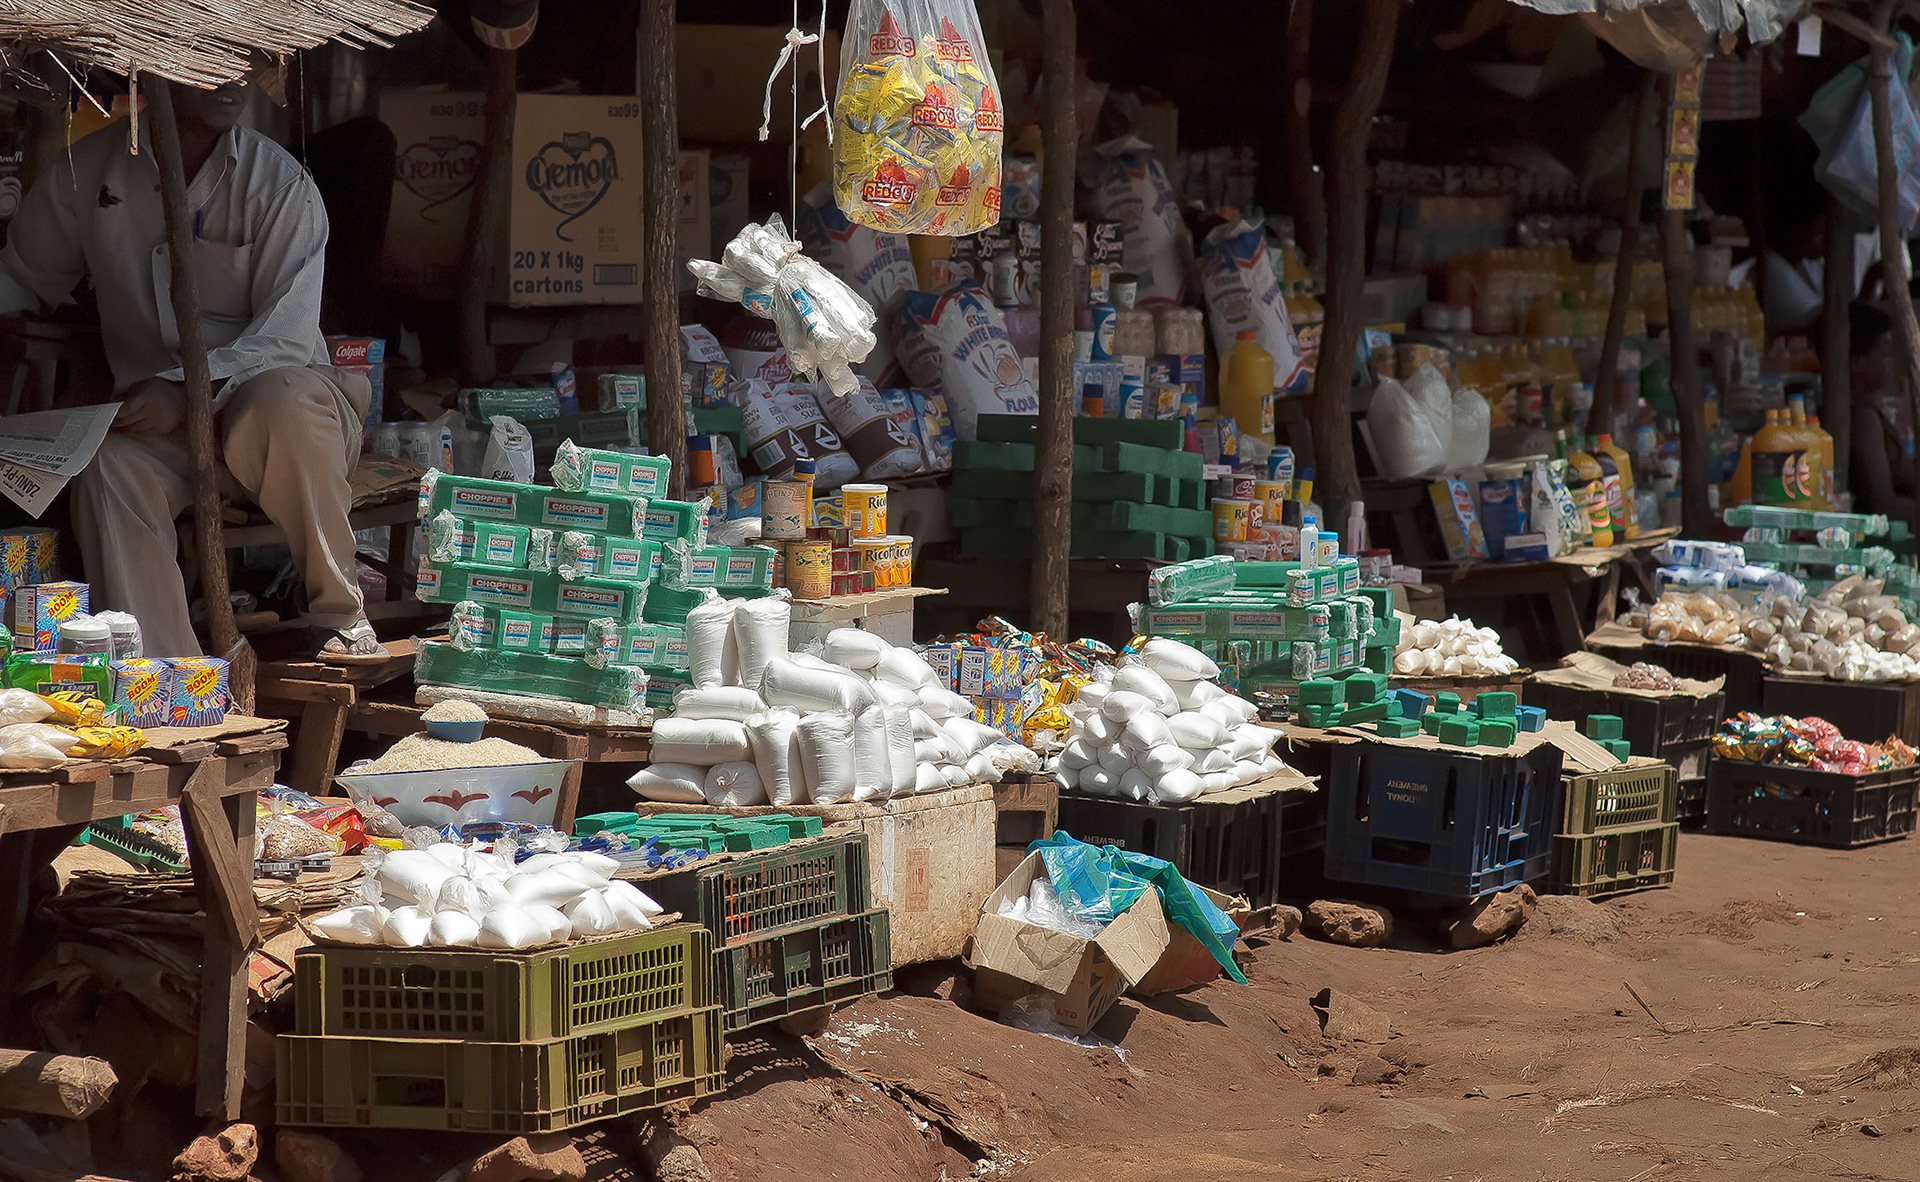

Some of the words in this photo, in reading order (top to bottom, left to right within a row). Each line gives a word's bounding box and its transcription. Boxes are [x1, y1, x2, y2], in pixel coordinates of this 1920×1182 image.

[526, 152, 618, 192] Cremora
[513, 251, 536, 270] 20
[540, 251, 551, 270] X
[557, 250, 585, 273] 1kg
[855, 249, 893, 286] WHITE
[892, 246, 912, 262] BRE
[513, 277, 585, 294] cartons
[952, 326, 989, 362] WHITE
[988, 325, 1012, 342] BRE
[336, 345, 367, 360] Colgate
[792, 401, 816, 412] BRO
[1004, 396, 1038, 414] FLOUR
[742, 407, 760, 421] OWN
[801, 410, 821, 420] SUG
[460, 492, 508, 504] CHOPPIES
[768, 488, 792, 499] HEINZ
[551, 503, 600, 515] CHOPPIES
[644, 512, 671, 523] PPIES
[7, 546, 25, 569] BOOM
[614, 553, 637, 562] CHOPPIES
[476, 580, 524, 592] CHOPPIES
[566, 589, 615, 601] CHOPPIES
[48, 592, 74, 618] BOOM
[1156, 614, 1199, 623] CHOPPIES
[1235, 614, 1279, 623] CHOPPIES
[127, 673, 156, 700] BOOM
[186, 668, 216, 694] BOOM
[648, 680, 676, 690] PPIES
[1266, 687, 1299, 695] CHOPPI
[1386, 780, 1429, 793] BREWERY
[1386, 791, 1416, 804] TIONAL
[1082, 834, 1126, 847] BREWERY
[1056, 1007, 1078, 1020] LTD
